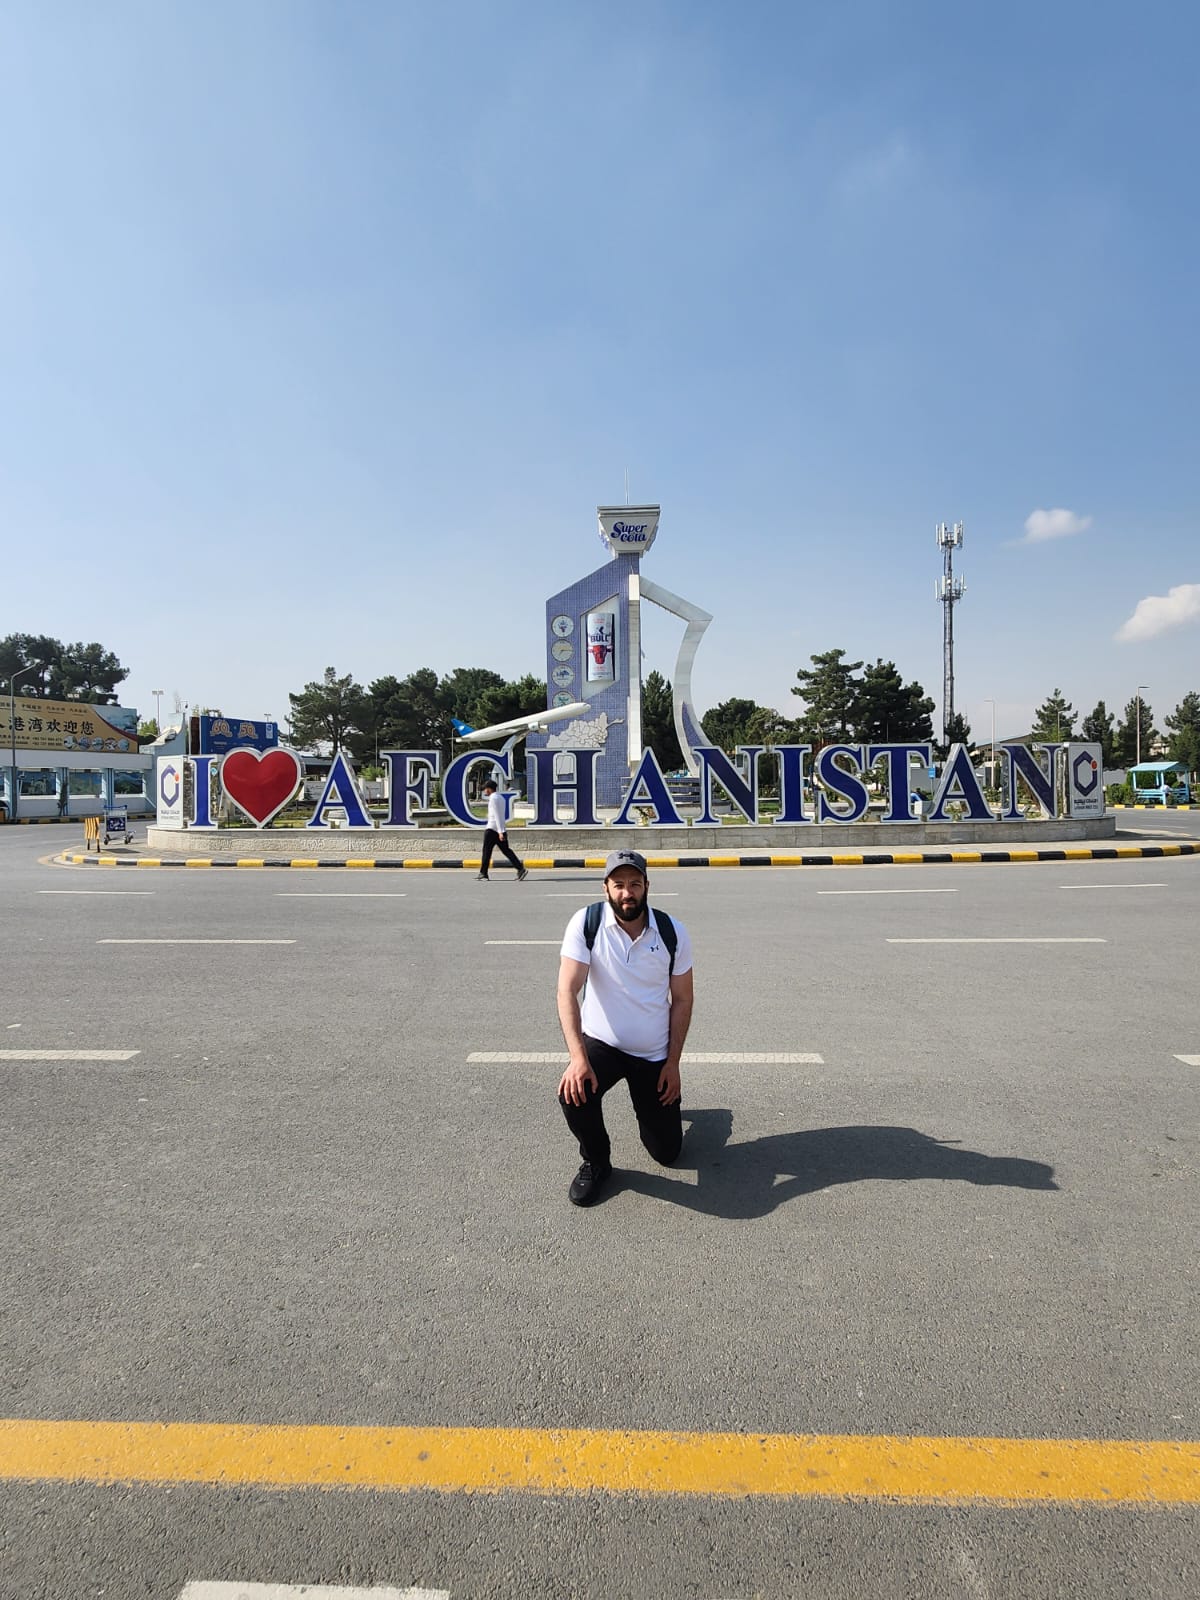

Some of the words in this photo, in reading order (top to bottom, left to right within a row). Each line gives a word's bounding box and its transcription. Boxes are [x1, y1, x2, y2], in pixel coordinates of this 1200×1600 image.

[610, 521, 648, 538] Super
[620, 532, 647, 543] cola
[0, 716, 95, 735] 港湾欢迎您
[188, 755, 218, 830] I
[306, 742, 1063, 829] AFGHANISTAN
